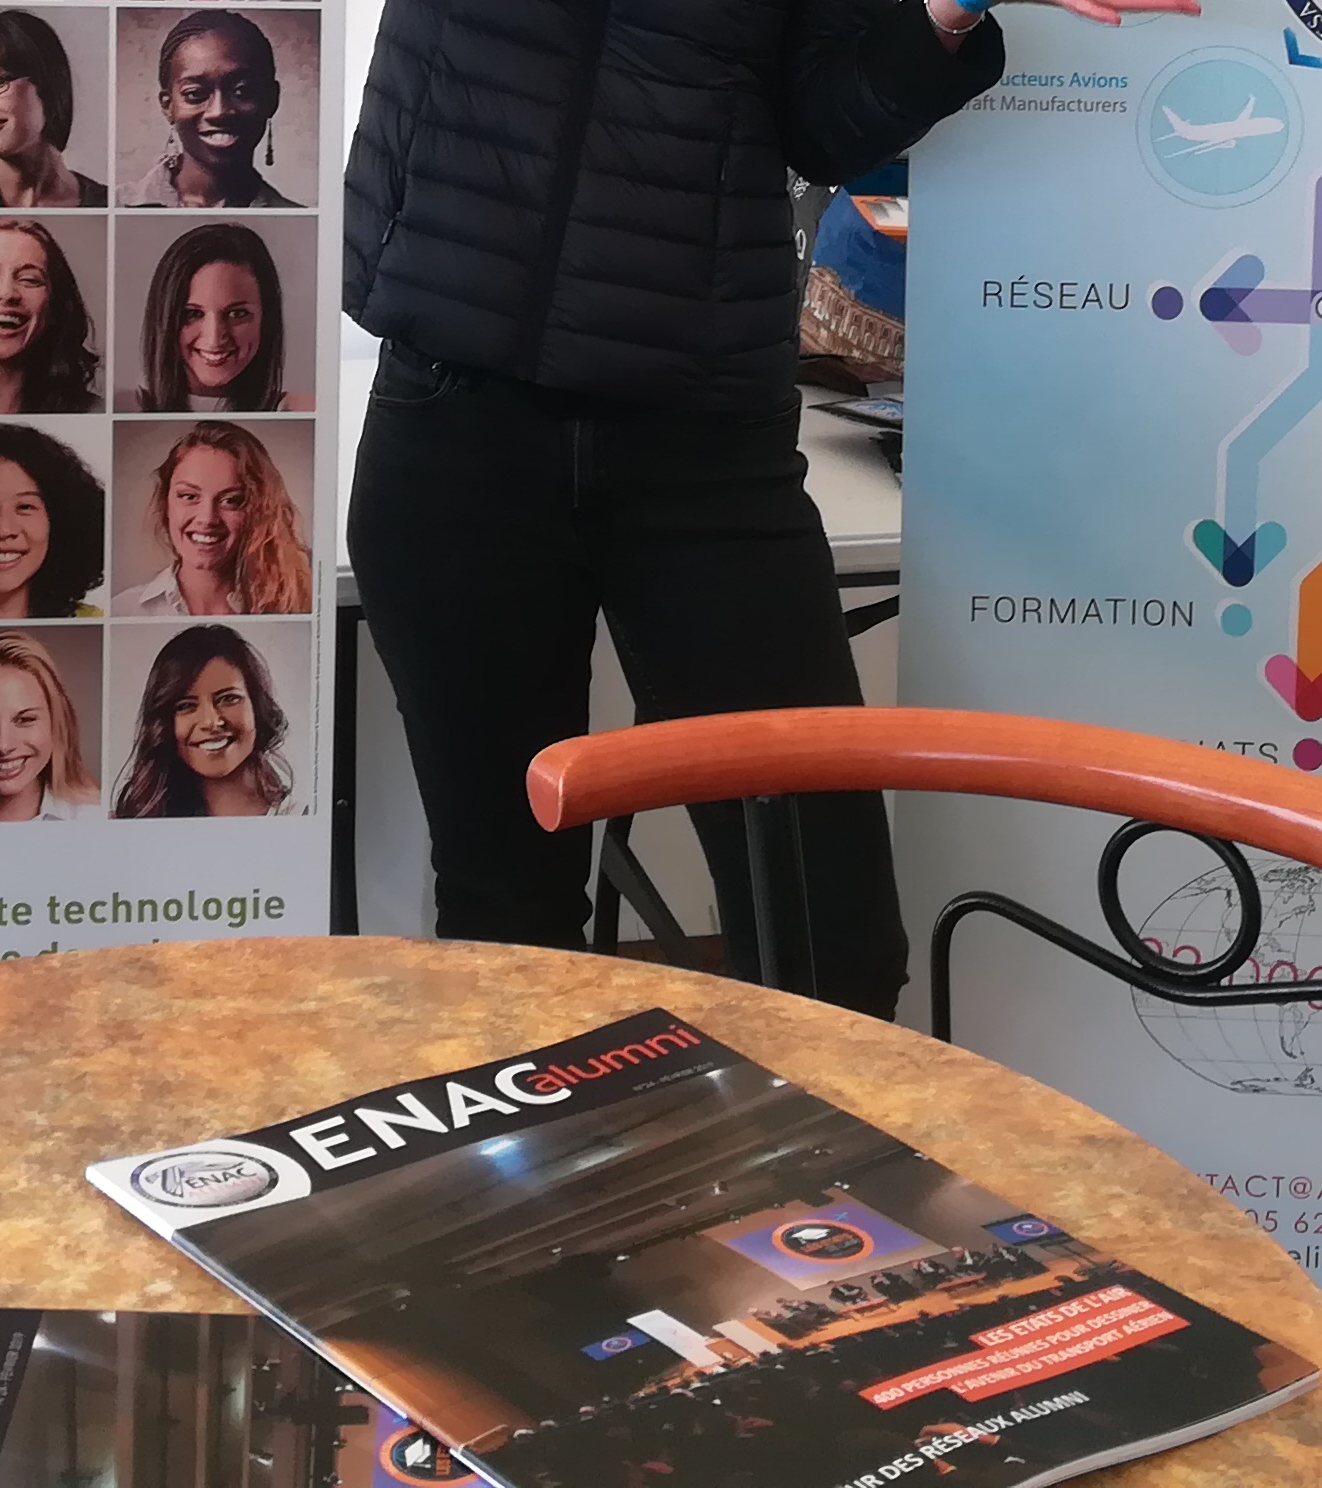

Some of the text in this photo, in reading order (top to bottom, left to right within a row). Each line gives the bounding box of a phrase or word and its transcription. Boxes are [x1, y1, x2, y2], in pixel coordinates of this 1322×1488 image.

[1068, 72, 1128, 89] Avions
[1000, 95, 1128, 112] Manufacturers
[981, 275, 1132, 311] RÉSEAU
[969, 596, 1195, 629] FORMATION
[47, 888, 285, 928] technologie
[289, 1024, 703, 1172] ENAC alumni
[185, 1167, 257, 1189] ENAC
[979, 1329, 1015, 1347] LES
[1059, 1301, 1090, 1318] DE
[900, 1358, 990, 1392] PERSONNES
[1046, 1324, 1091, 1346] POUR
[1016, 1357, 1044, 1374] DU
[1038, 1329, 1124, 1365] TRANSPORT
[878, 1391, 1090, 1480] DES RÉSEAUX ALUMNI
